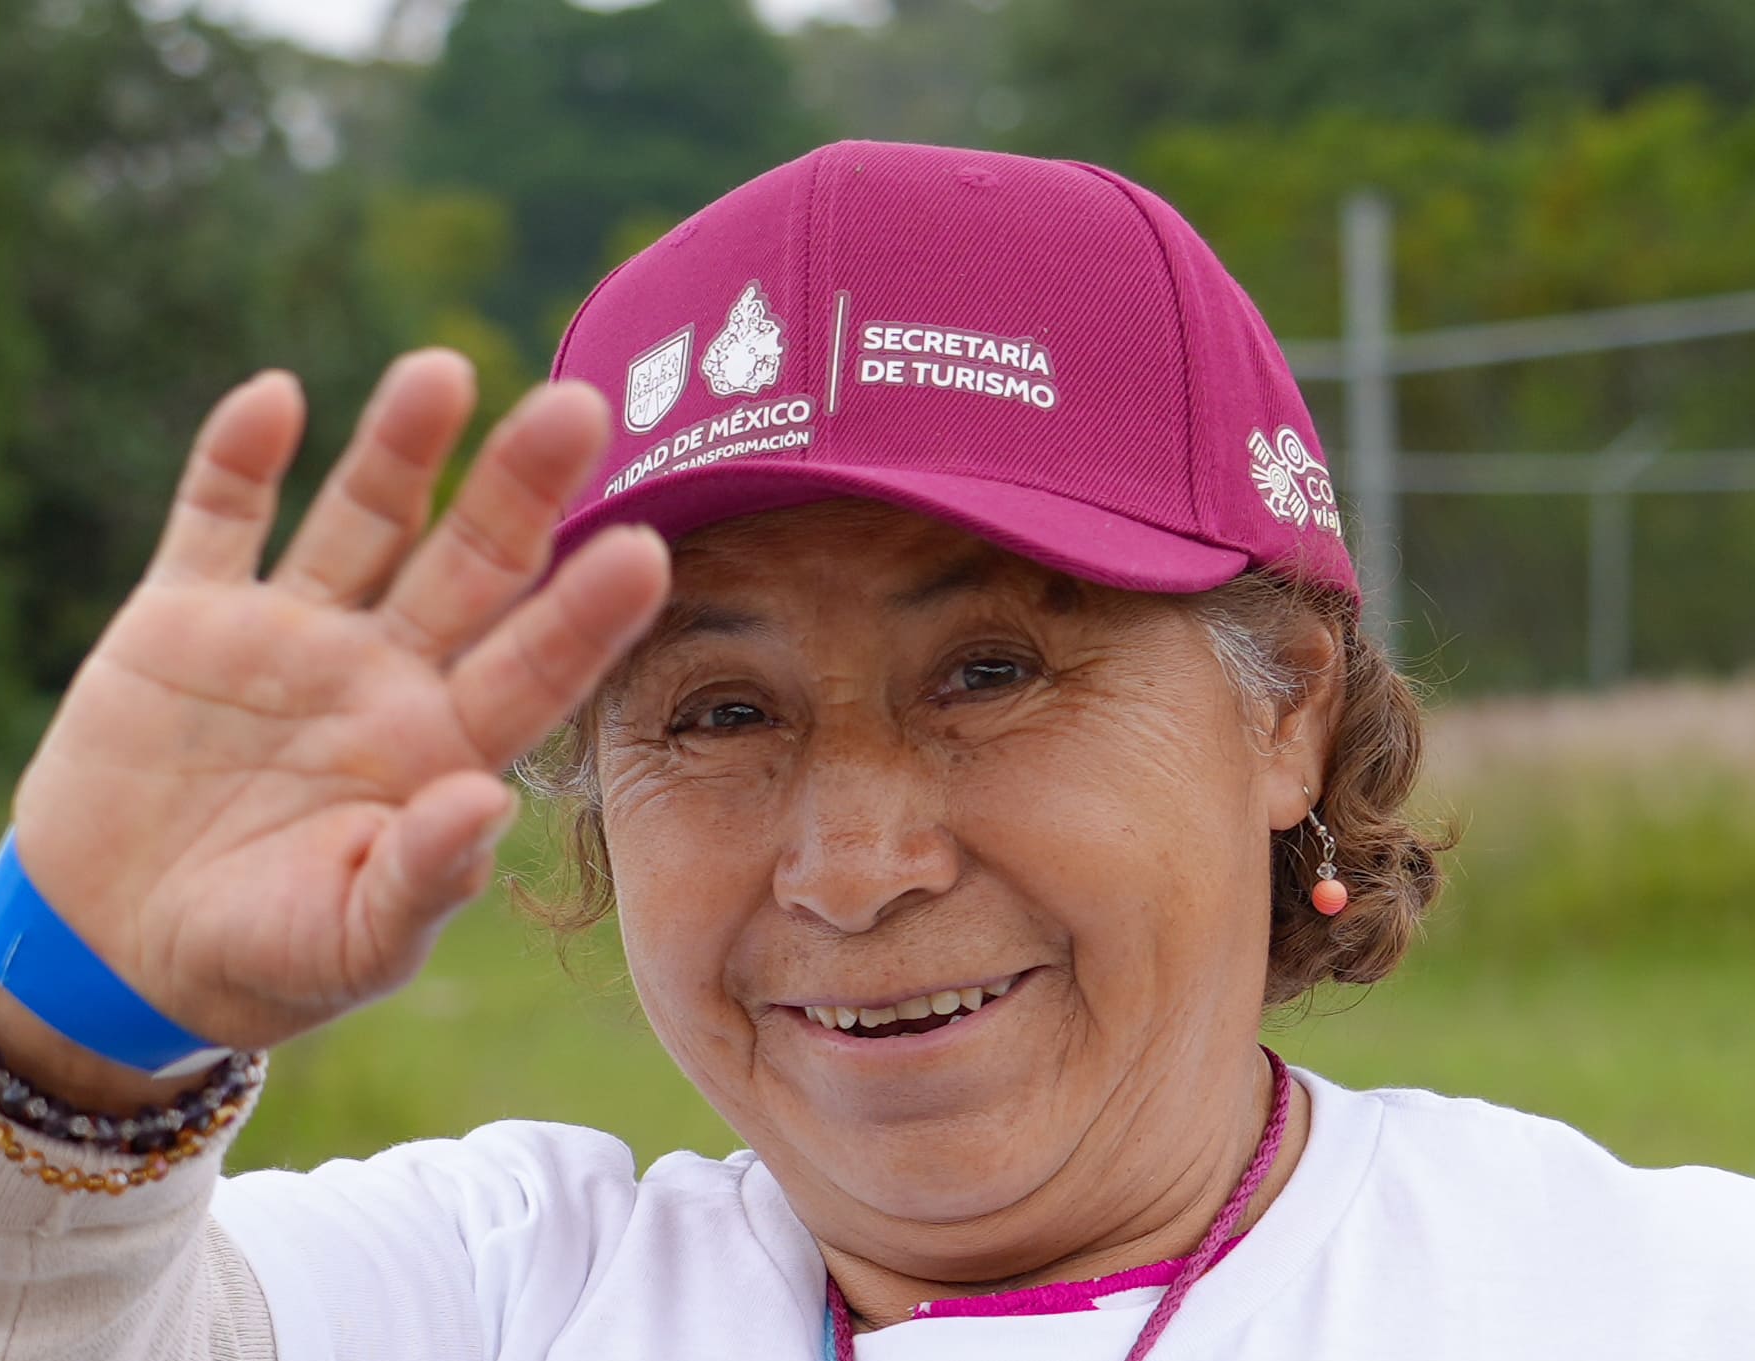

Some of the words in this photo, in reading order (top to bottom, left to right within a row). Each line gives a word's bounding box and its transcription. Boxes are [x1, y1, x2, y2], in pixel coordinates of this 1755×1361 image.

[863, 326, 1049, 376] SECRETARÍA
[861, 360, 905, 383] DE
[912, 361, 1056, 409] TURISMO
[604, 445, 669, 500] CIUDAD
[672, 426, 705, 459] DE
[707, 400, 811, 443] MÉXICO
